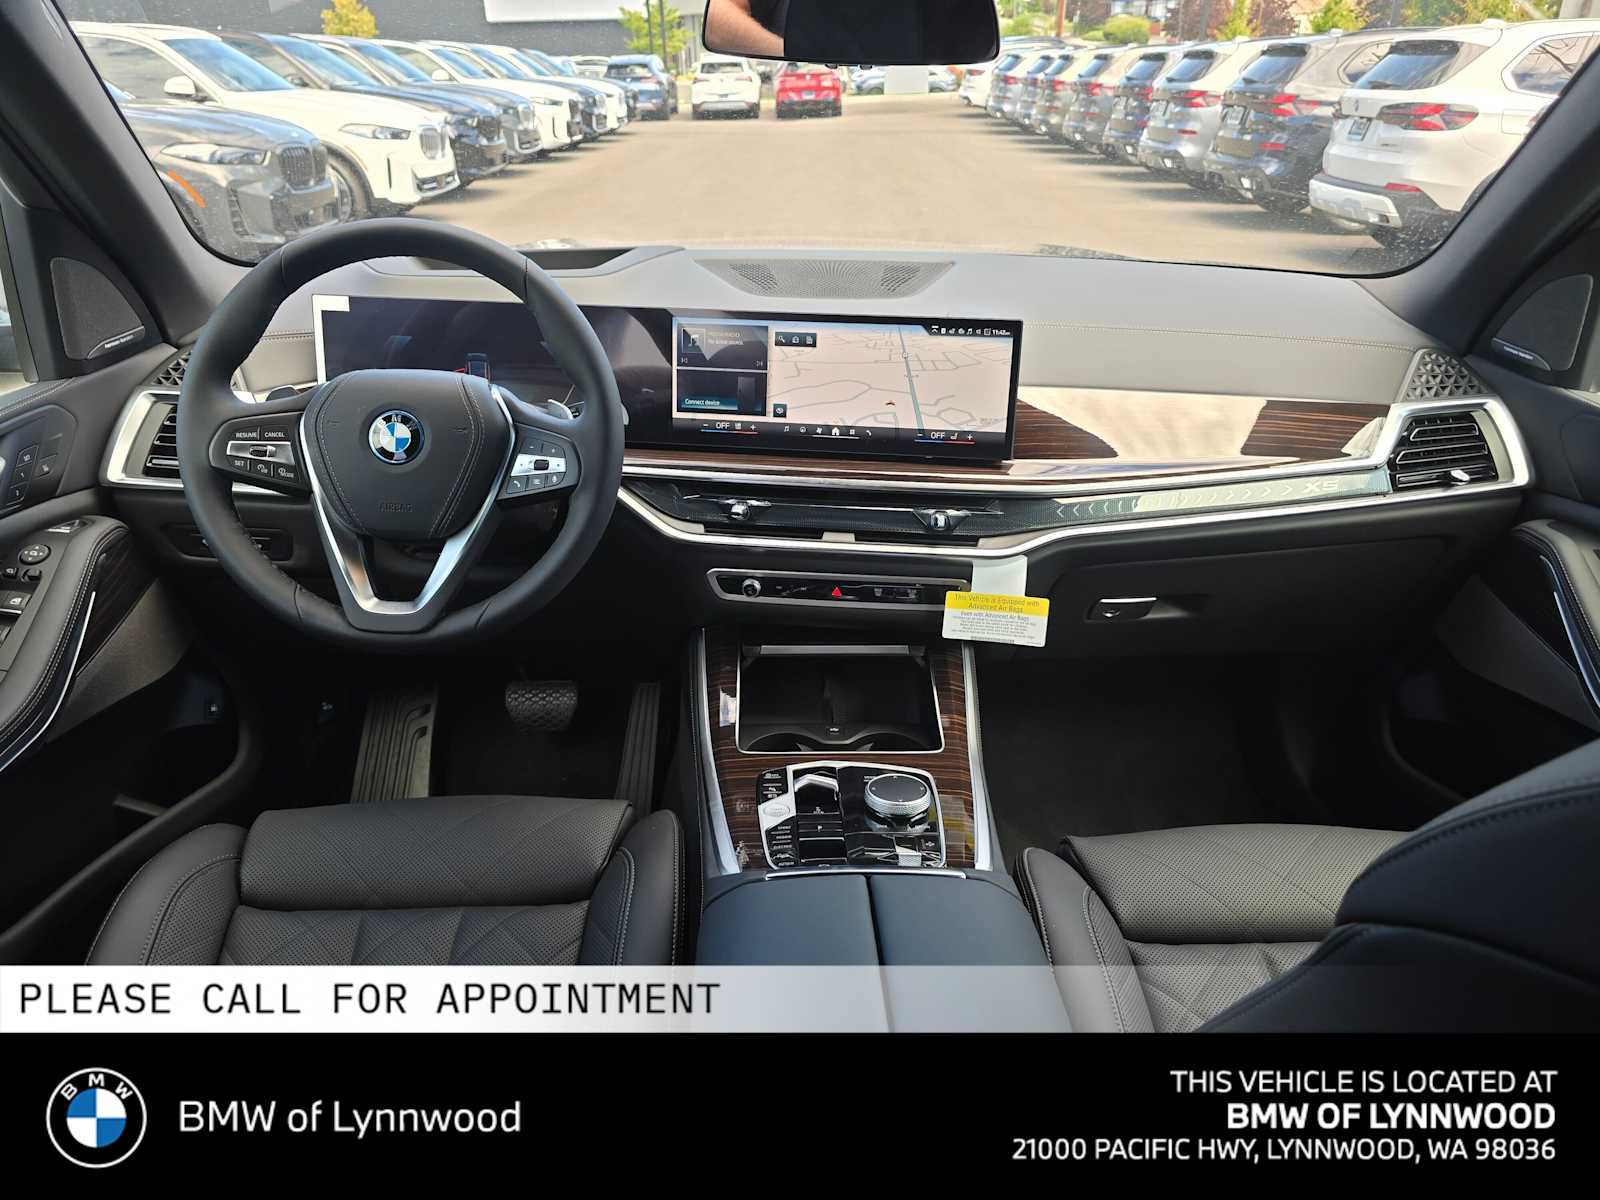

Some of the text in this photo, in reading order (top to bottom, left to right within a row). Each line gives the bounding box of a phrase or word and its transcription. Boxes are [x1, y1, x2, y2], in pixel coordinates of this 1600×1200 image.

[715, 422, 730, 430] OFF
[930, 432, 945, 440] OFF
[1302, 478, 1338, 494] X5
[968, 602, 997, 611] Advanced
